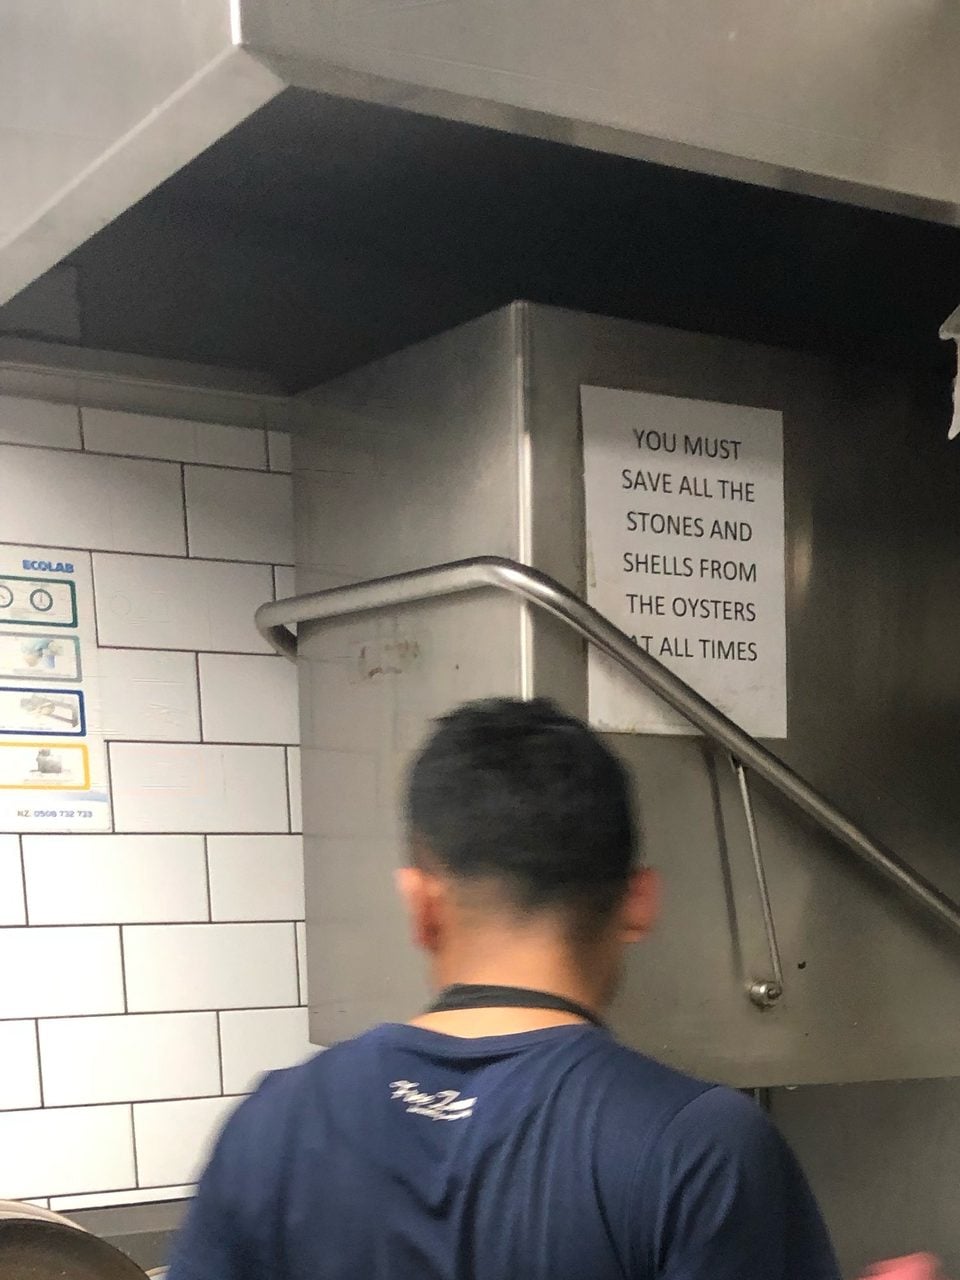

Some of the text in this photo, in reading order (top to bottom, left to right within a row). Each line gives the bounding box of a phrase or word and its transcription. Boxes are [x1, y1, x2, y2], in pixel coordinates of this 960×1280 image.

[633, 428, 742, 461] YOU MUST
[621, 469, 755, 503] SAVE ALL THE
[626, 511, 753, 542] STONES AND
[22, 559, 74, 574] ECOLAB
[623, 552, 757, 583] SHELLS FROM
[626, 594, 757, 623] THE OYSTERS
[659, 637, 694, 658] ALL
[698, 639, 758, 662] TIMES
